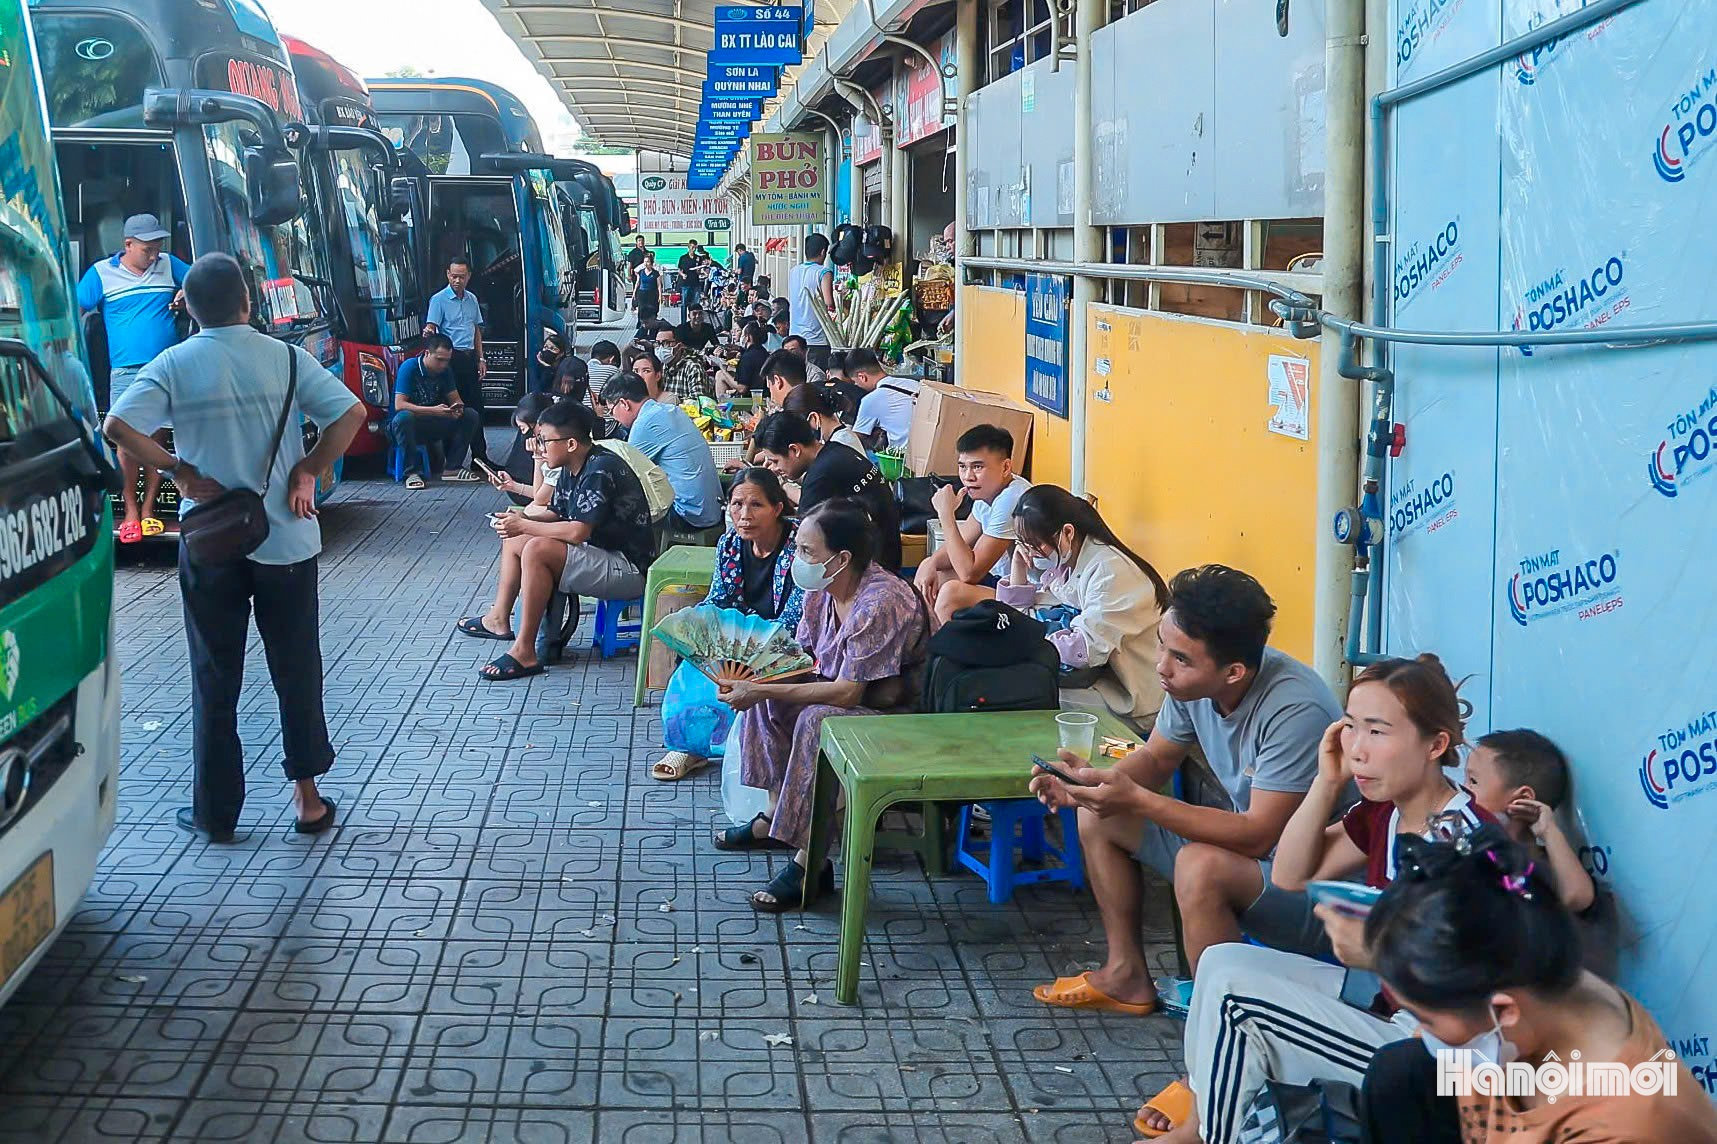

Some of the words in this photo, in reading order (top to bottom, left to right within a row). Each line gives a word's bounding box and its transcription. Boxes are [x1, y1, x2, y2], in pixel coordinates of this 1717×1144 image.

[755, 7, 773, 20] Số
[775, 8, 791, 19] 44
[721, 34, 736, 49] BX
[739, 34, 751, 49] TT
[754, 31, 775, 49] LÀO
[778, 34, 796, 49] CAI
[725, 66, 746, 77] SƠN
[748, 67, 759, 77] LA
[748, 81, 771, 91] NHAI
[756, 137, 818, 161] BÚN
[758, 162, 818, 190] PHỞ
[1528, 257, 1623, 332] POSHACO
[61, 484, 87, 546] 282
[1523, 553, 1617, 610] POSHACO
[1657, 728, 1686, 752] TÔN
